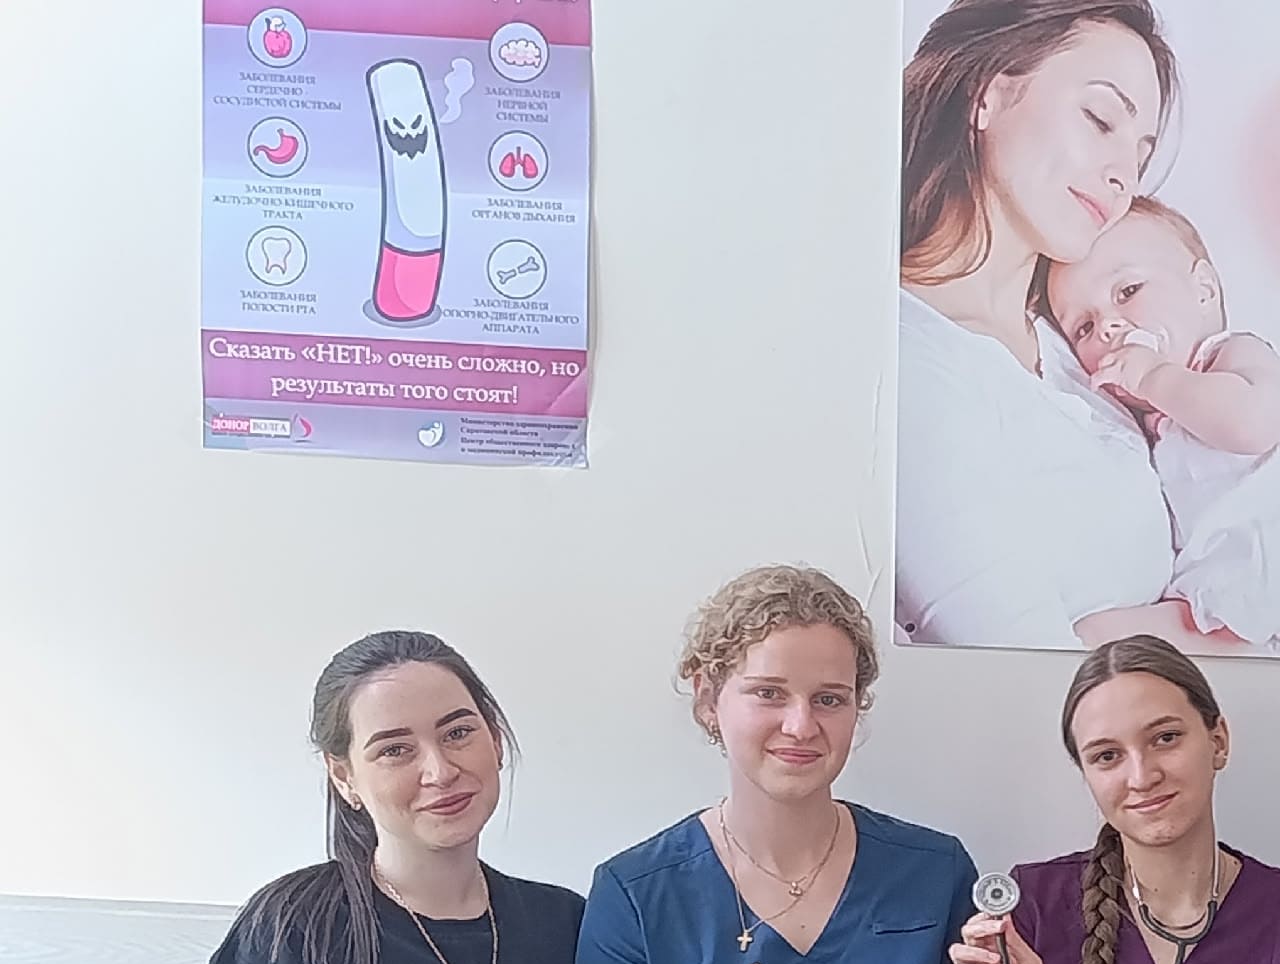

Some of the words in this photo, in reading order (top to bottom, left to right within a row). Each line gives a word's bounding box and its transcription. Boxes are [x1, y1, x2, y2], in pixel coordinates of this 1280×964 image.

[262, 209, 303, 220] ТРАКТА
[208, 337, 296, 361] Сказать
[301, 342, 384, 365] «НЕТ!»
[388, 352, 453, 370] очень
[457, 355, 547, 377] сложно,
[551, 361, 580, 376] но
[270, 376, 397, 400] результаты
[399, 383, 448, 400] того
[452, 385, 519, 404] стоят!
